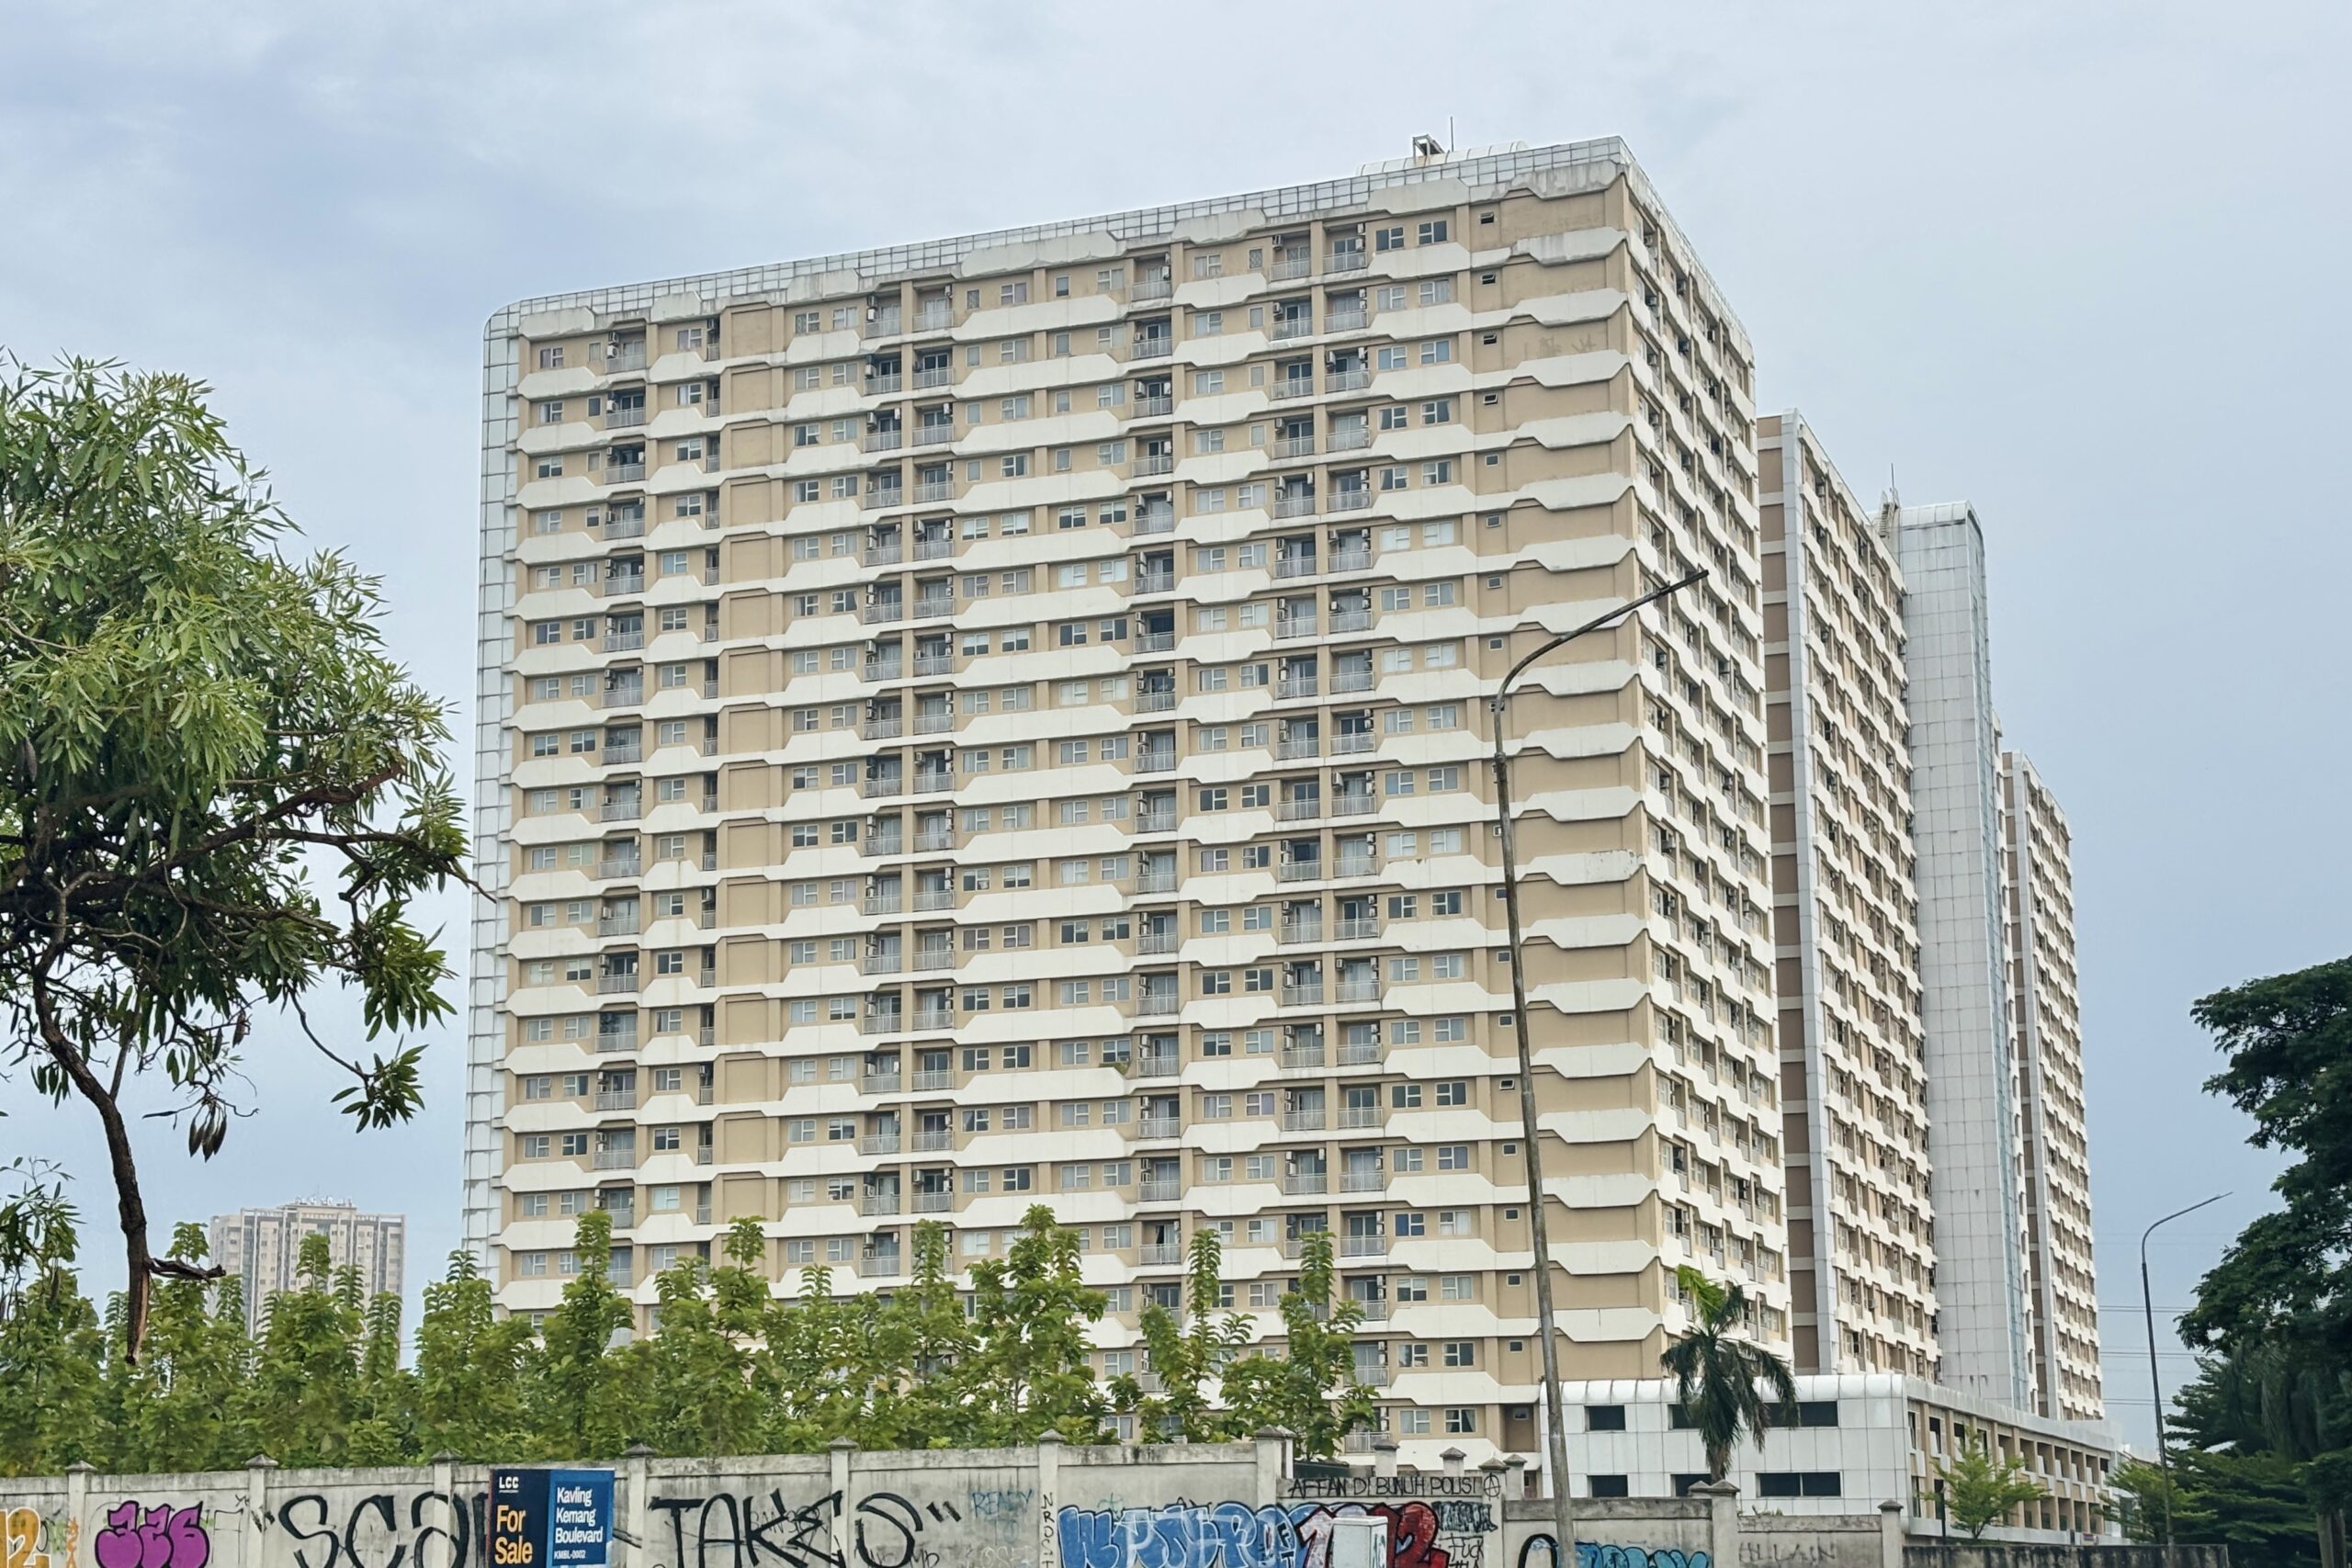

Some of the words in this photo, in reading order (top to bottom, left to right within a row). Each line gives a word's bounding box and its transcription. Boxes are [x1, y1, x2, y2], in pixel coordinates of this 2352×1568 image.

[499, 1476, 519, 1488] LCC
[557, 1486, 593, 1507] Kavling
[497, 1505, 526, 1533] For
[556, 1507, 596, 1527] Kemang
[555, 1526, 604, 1544] Boulevard
[494, 1536, 533, 1564] Sale
